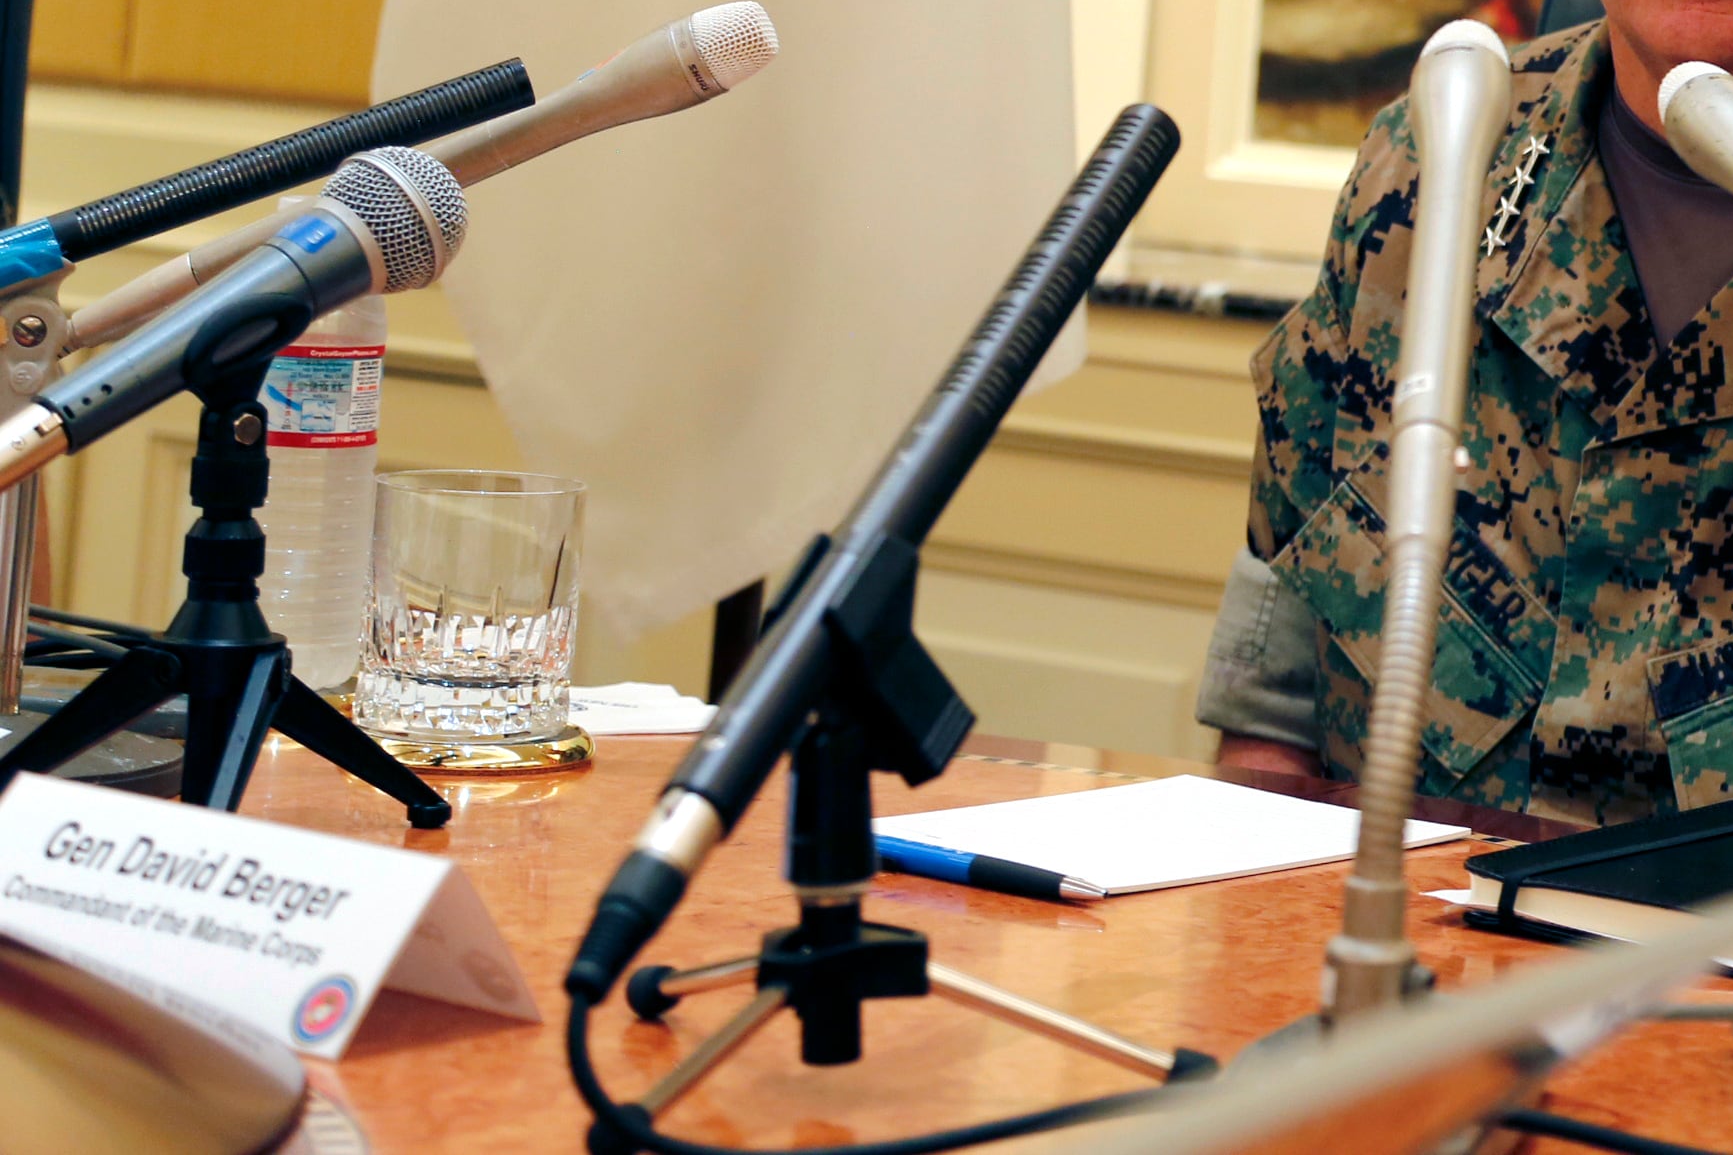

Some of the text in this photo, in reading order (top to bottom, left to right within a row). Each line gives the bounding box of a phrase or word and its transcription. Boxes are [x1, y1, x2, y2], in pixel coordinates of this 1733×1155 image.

[44, 820, 351, 922] Gen David Berger
[4, 874, 132, 924] Commandant
[154, 905, 188, 936] the
[190, 914, 259, 952] Marine
[260, 932, 324, 968] Corps
